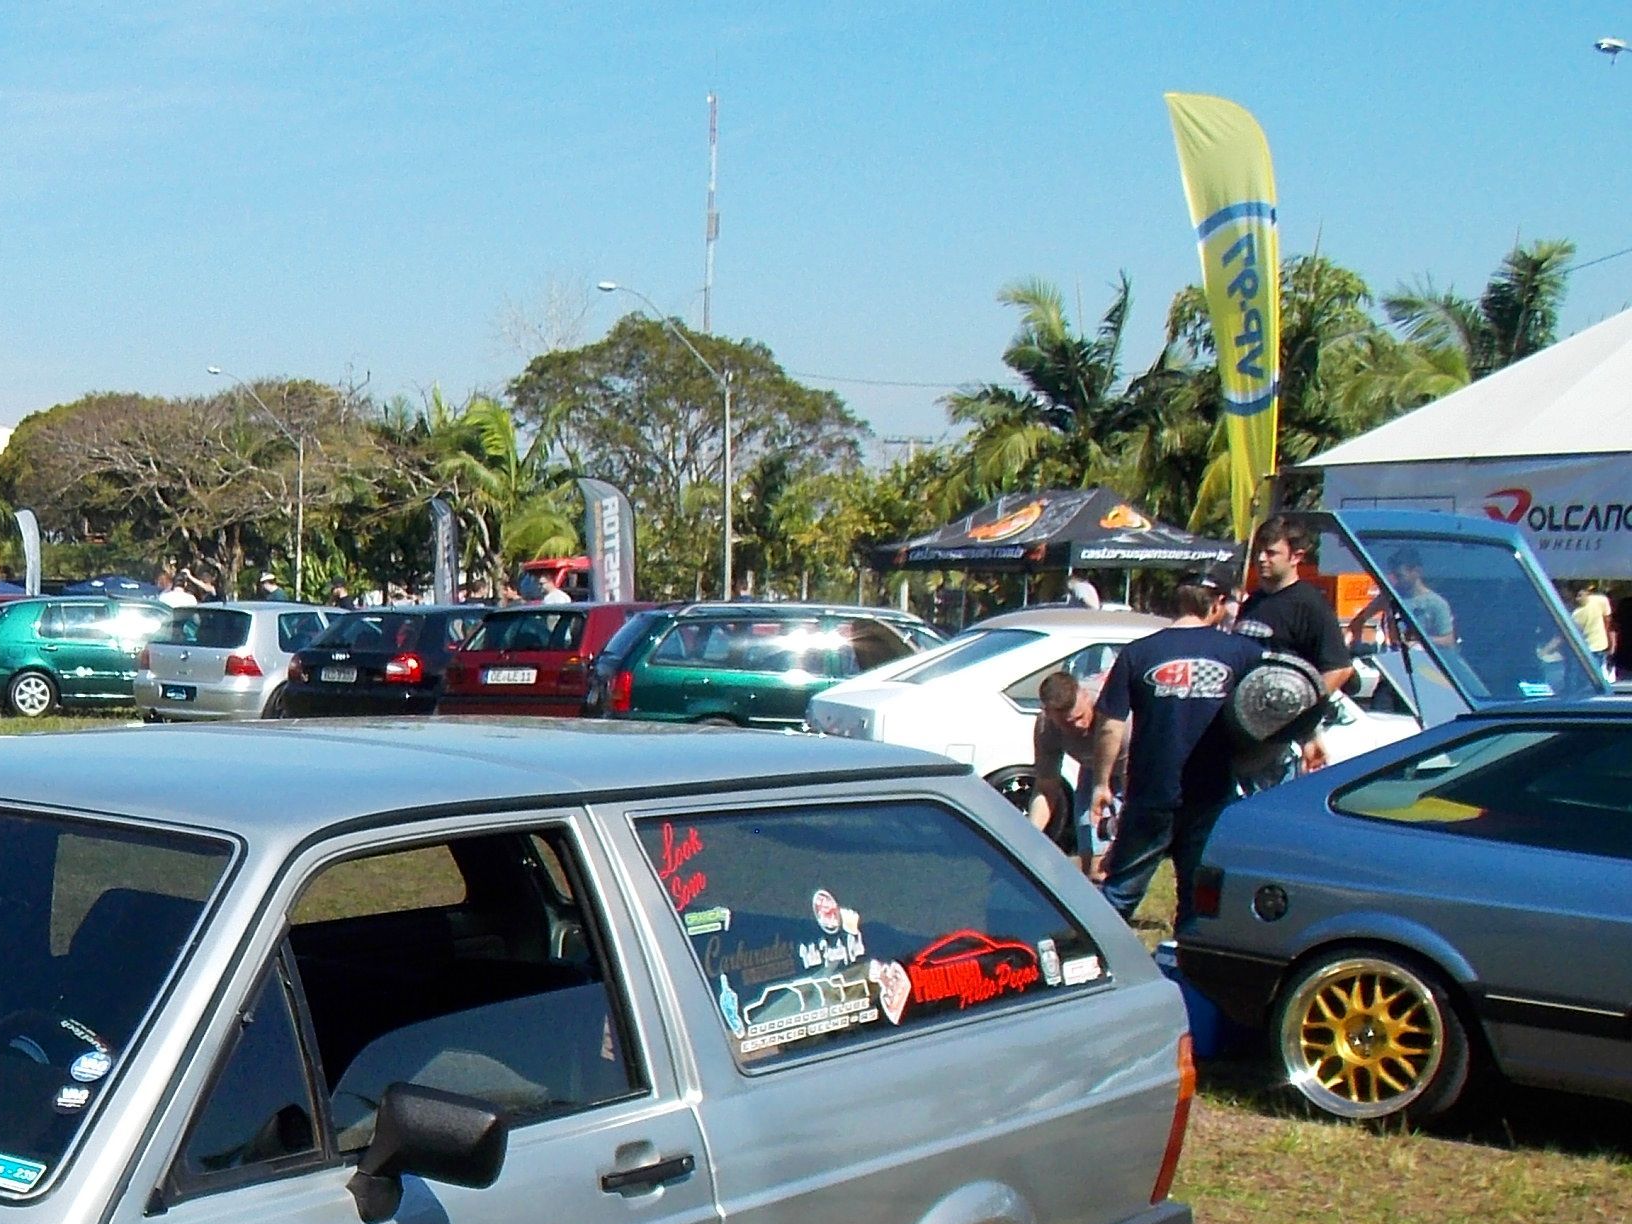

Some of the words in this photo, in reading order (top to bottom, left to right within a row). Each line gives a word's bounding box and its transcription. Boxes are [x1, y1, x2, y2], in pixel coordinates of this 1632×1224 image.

[1539, 538, 1602, 551] WHEELS
[749, 1008, 828, 1036] QUADRADOS
[831, 999, 869, 1015] CLUBE
